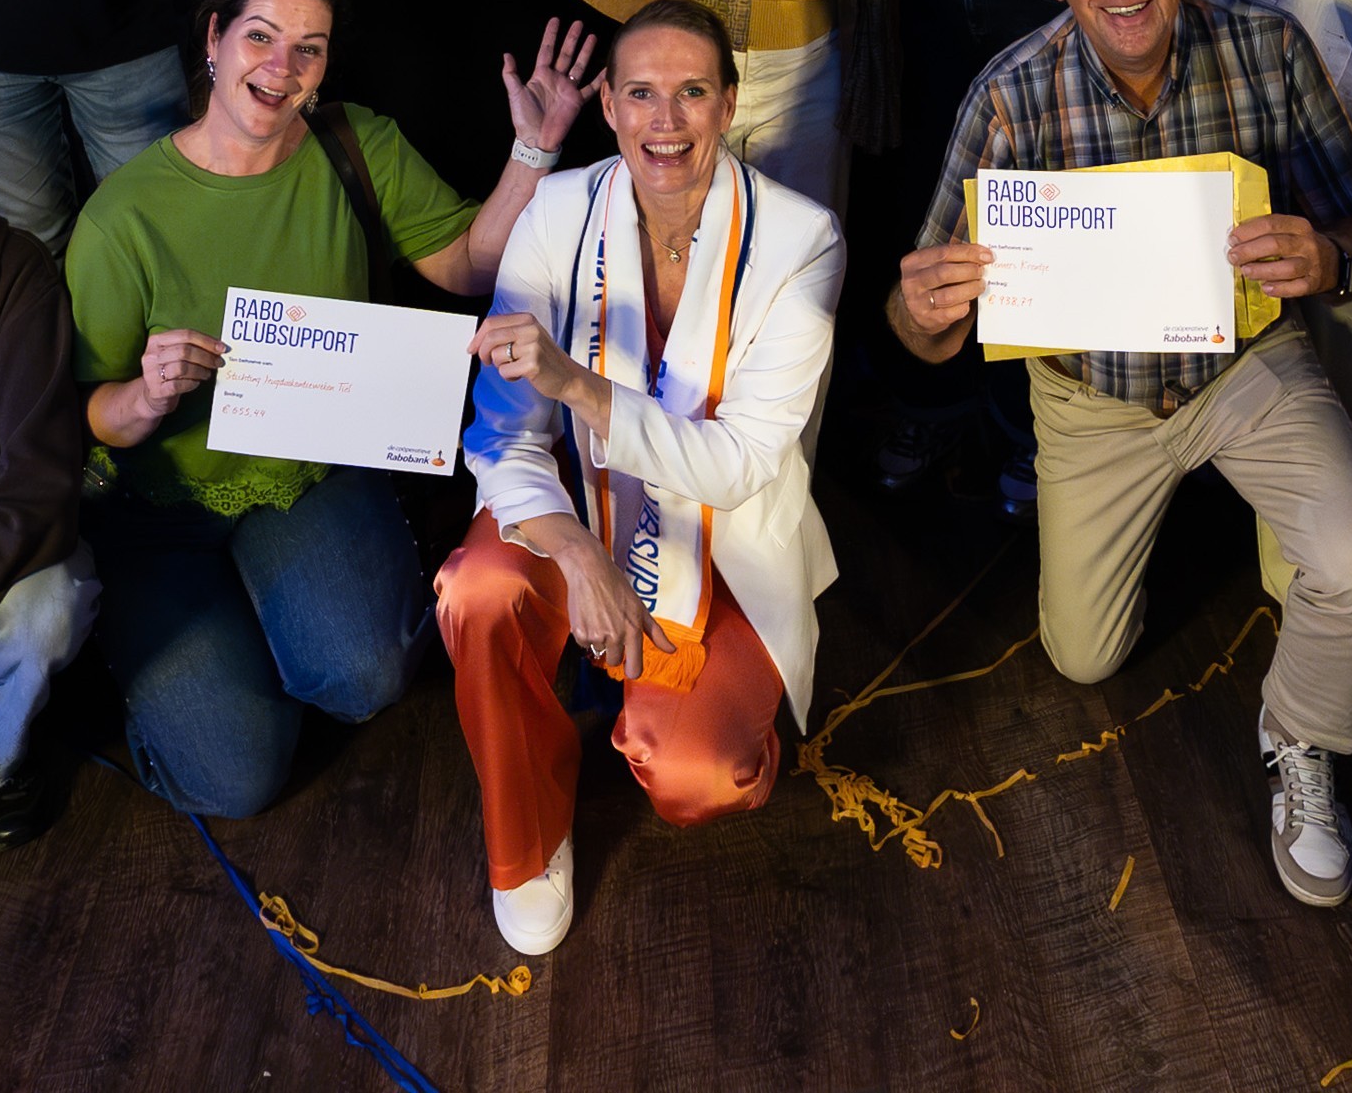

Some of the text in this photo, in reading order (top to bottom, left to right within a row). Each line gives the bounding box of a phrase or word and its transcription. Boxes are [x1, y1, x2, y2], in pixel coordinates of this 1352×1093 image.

[988, 180, 1036, 203] RABO
[988, 204, 1117, 230] CLUBSUPPORT
[234, 298, 284, 322] RABO
[231, 320, 359, 354] CLUBSUPPORT
[1163, 334, 1208, 343] Rabobank
[226, 370, 261, 385] Stichting
[339, 382, 352, 393] Tiel
[387, 452, 429, 466] Rabobank
